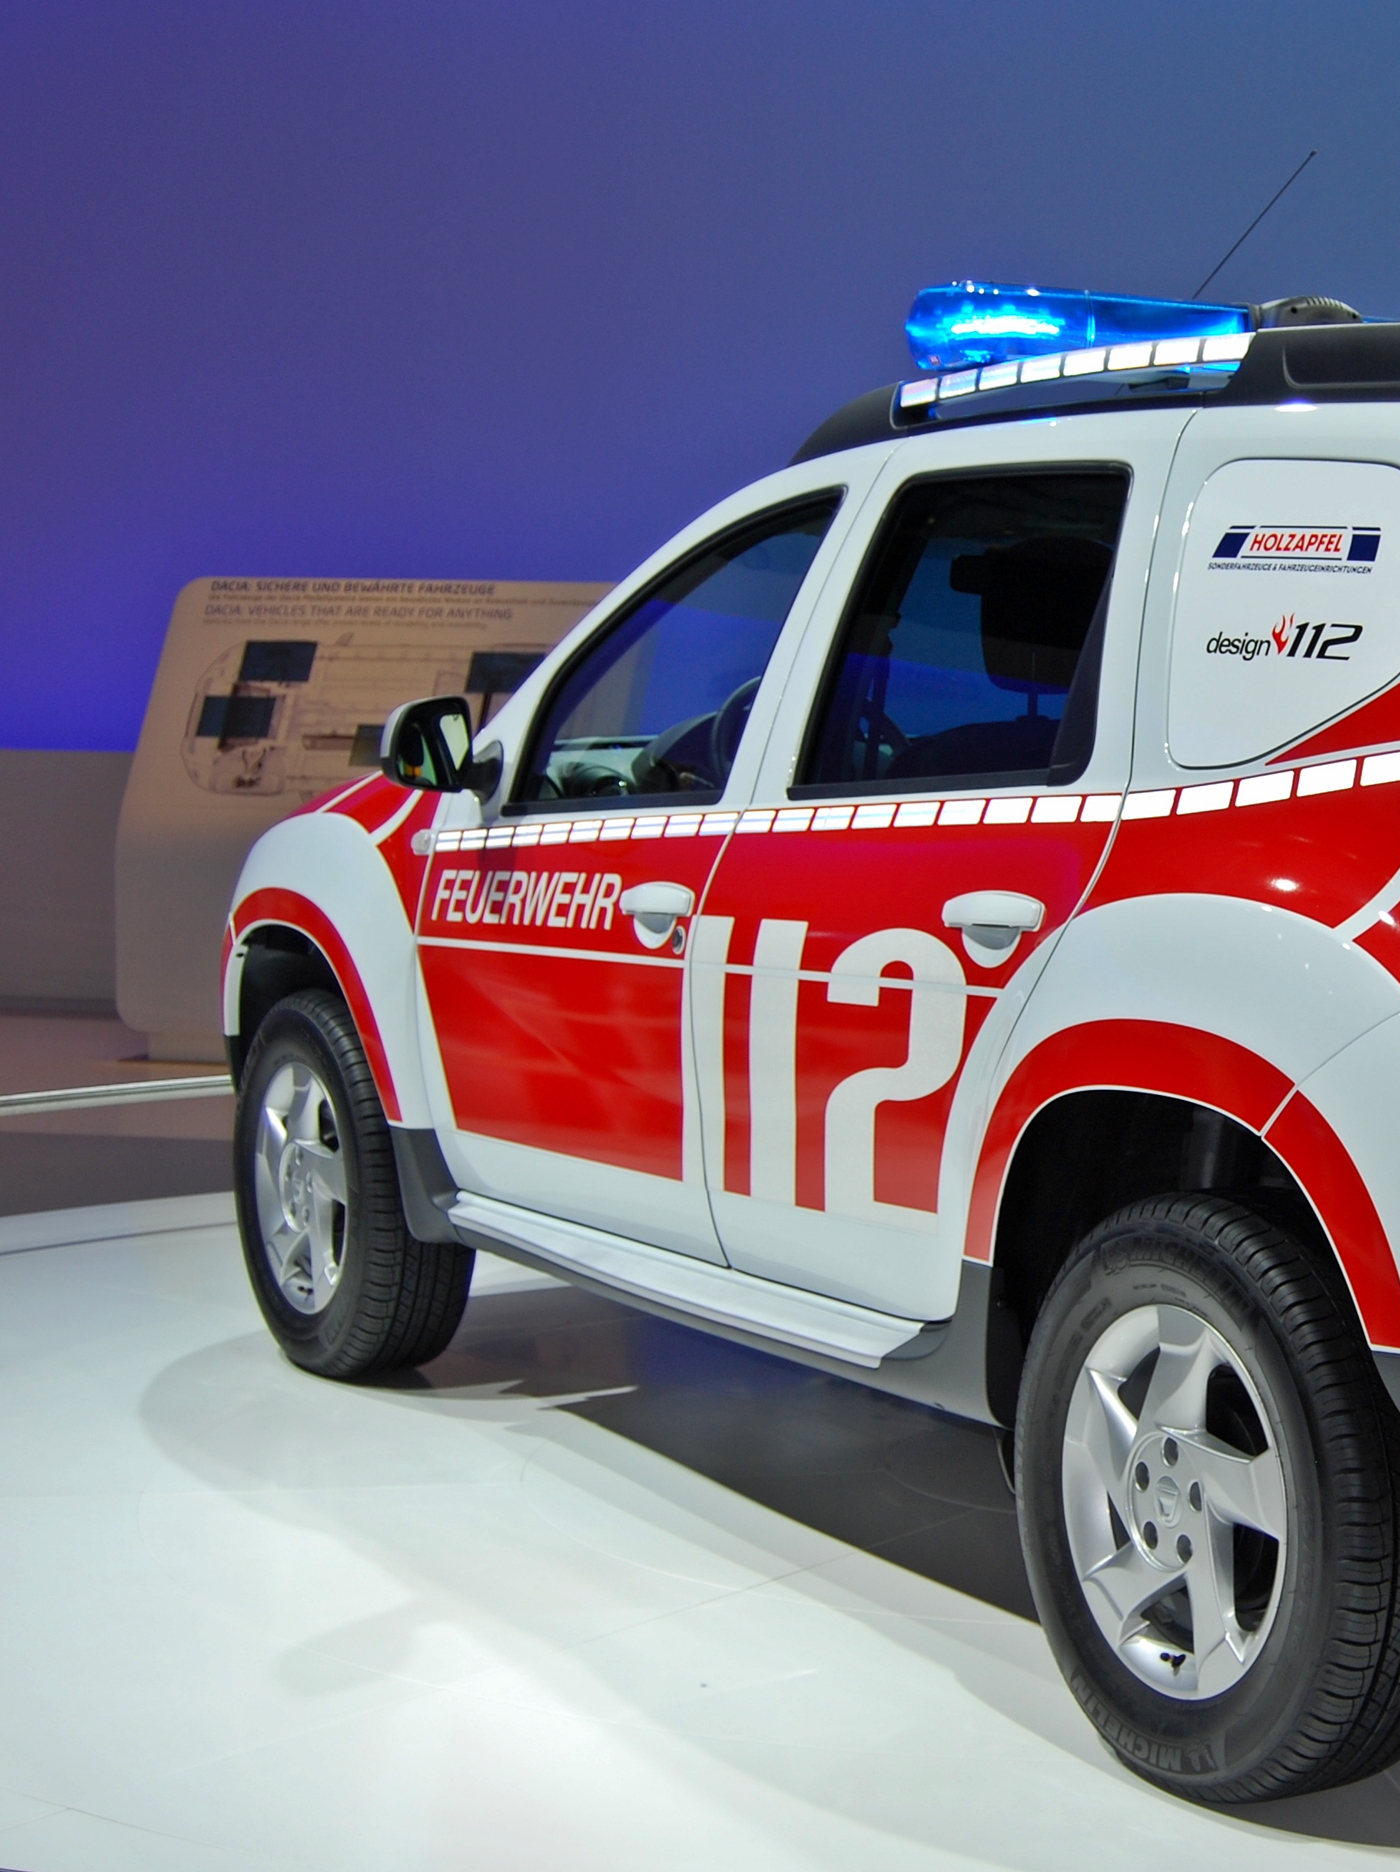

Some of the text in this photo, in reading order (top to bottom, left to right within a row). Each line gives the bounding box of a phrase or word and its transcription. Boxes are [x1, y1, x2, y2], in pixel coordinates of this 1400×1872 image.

[1249, 533, 1344, 553] HOLZAPFEL
[256, 581, 308, 592] SICHERE
[312, 581, 340, 592] UND
[343, 580, 414, 593] BEWÄHRTE
[418, 582, 496, 595] FAHRZEUGE
[248, 604, 306, 617] VEHICLES
[310, 605, 342, 617] THAT
[345, 605, 369, 617] ARE
[372, 606, 415, 618] READY
[418, 606, 444, 619] FOR
[446, 607, 513, 620] ANYTHING
[1206, 622, 1364, 661] design 112
[430, 869, 623, 931] FEUERWEHR
[683, 914, 967, 1234] 112
[1070, 1676, 1182, 1772] MICHELIN
